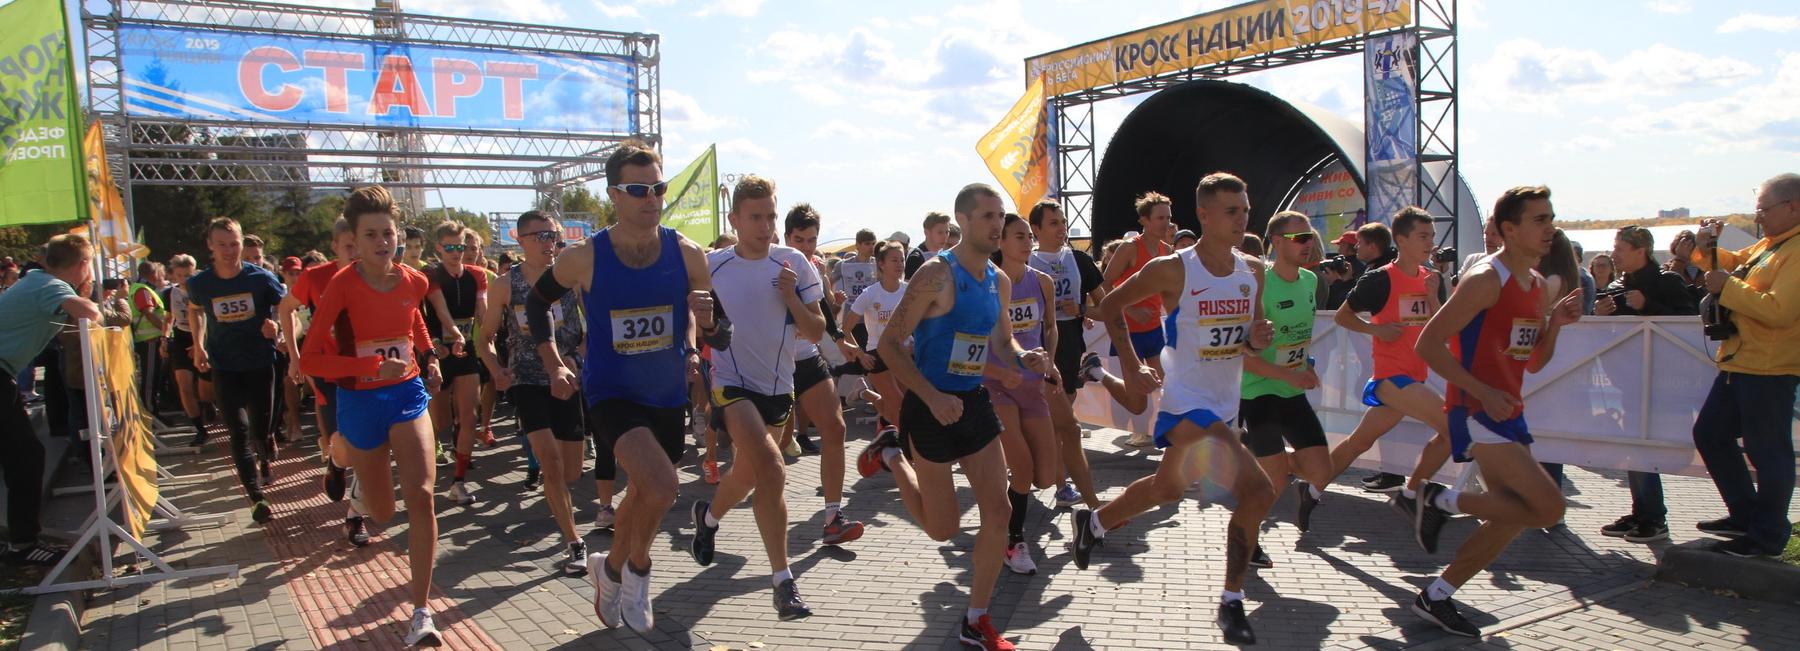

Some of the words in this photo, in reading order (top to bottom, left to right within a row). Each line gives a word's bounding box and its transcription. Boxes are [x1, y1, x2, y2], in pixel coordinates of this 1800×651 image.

[185, 37, 220, 49] 2019
[1115, 33, 1180, 73] КРОСС
[1187, 8, 1286, 58] НАЦИИ
[1292, 0, 1361, 35] 2019
[238, 46, 538, 120] СТАРТ
[1299, 190, 1333, 204] ЖИВИ
[221, 300, 248, 315] 355
[1199, 299, 1250, 316] RUSSIA
[1411, 301, 1426, 314] 41
[622, 316, 665, 339] 320
[1210, 326, 1244, 347] 372
[968, 344, 985, 362] 97
[1287, 347, 1304, 363] 24
